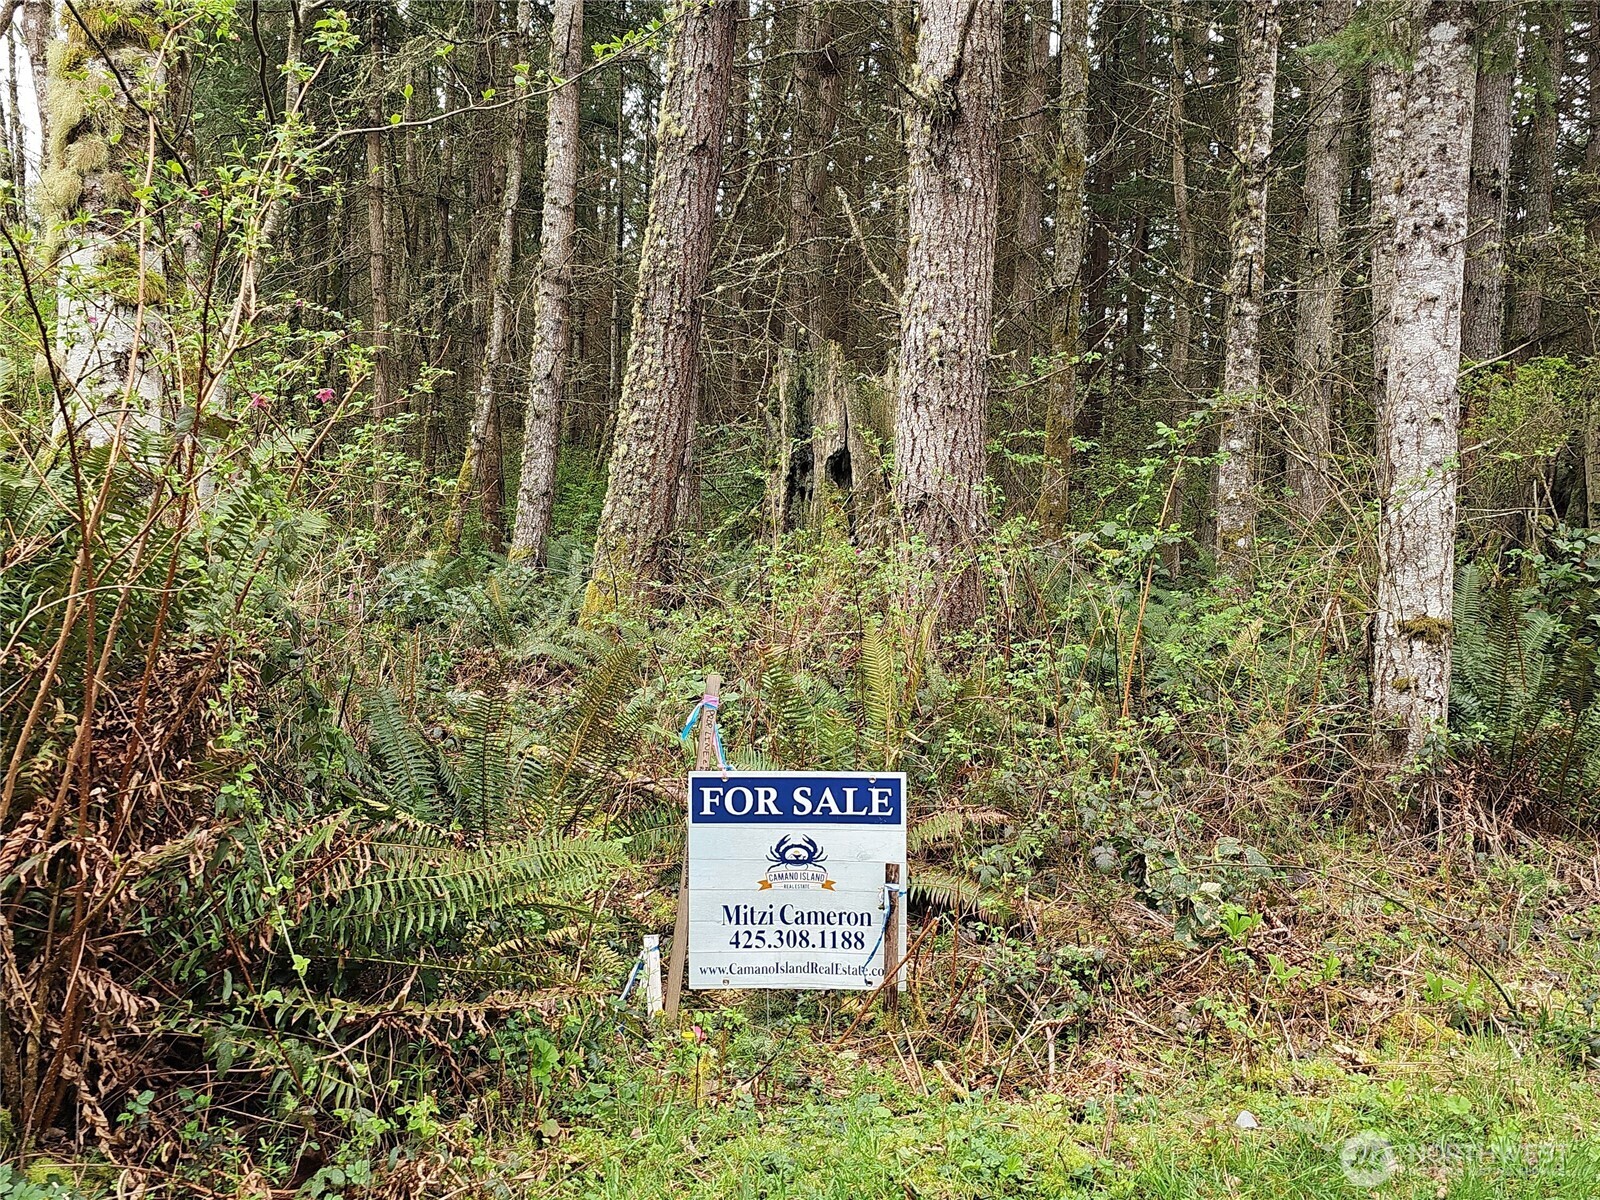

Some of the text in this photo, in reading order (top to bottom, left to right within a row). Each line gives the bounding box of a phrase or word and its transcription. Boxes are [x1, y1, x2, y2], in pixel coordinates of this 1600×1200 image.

[702, 731, 711, 757] LINE
[699, 786, 893, 816] FOR SALE
[768, 872, 825, 882] CAMANO ISLAND
[721, 904, 872, 927] Mitzi Cameron
[729, 930, 865, 950] 425.308.1188
[699, 961, 885, 977] www.CamanoIslandRealEstate.co
